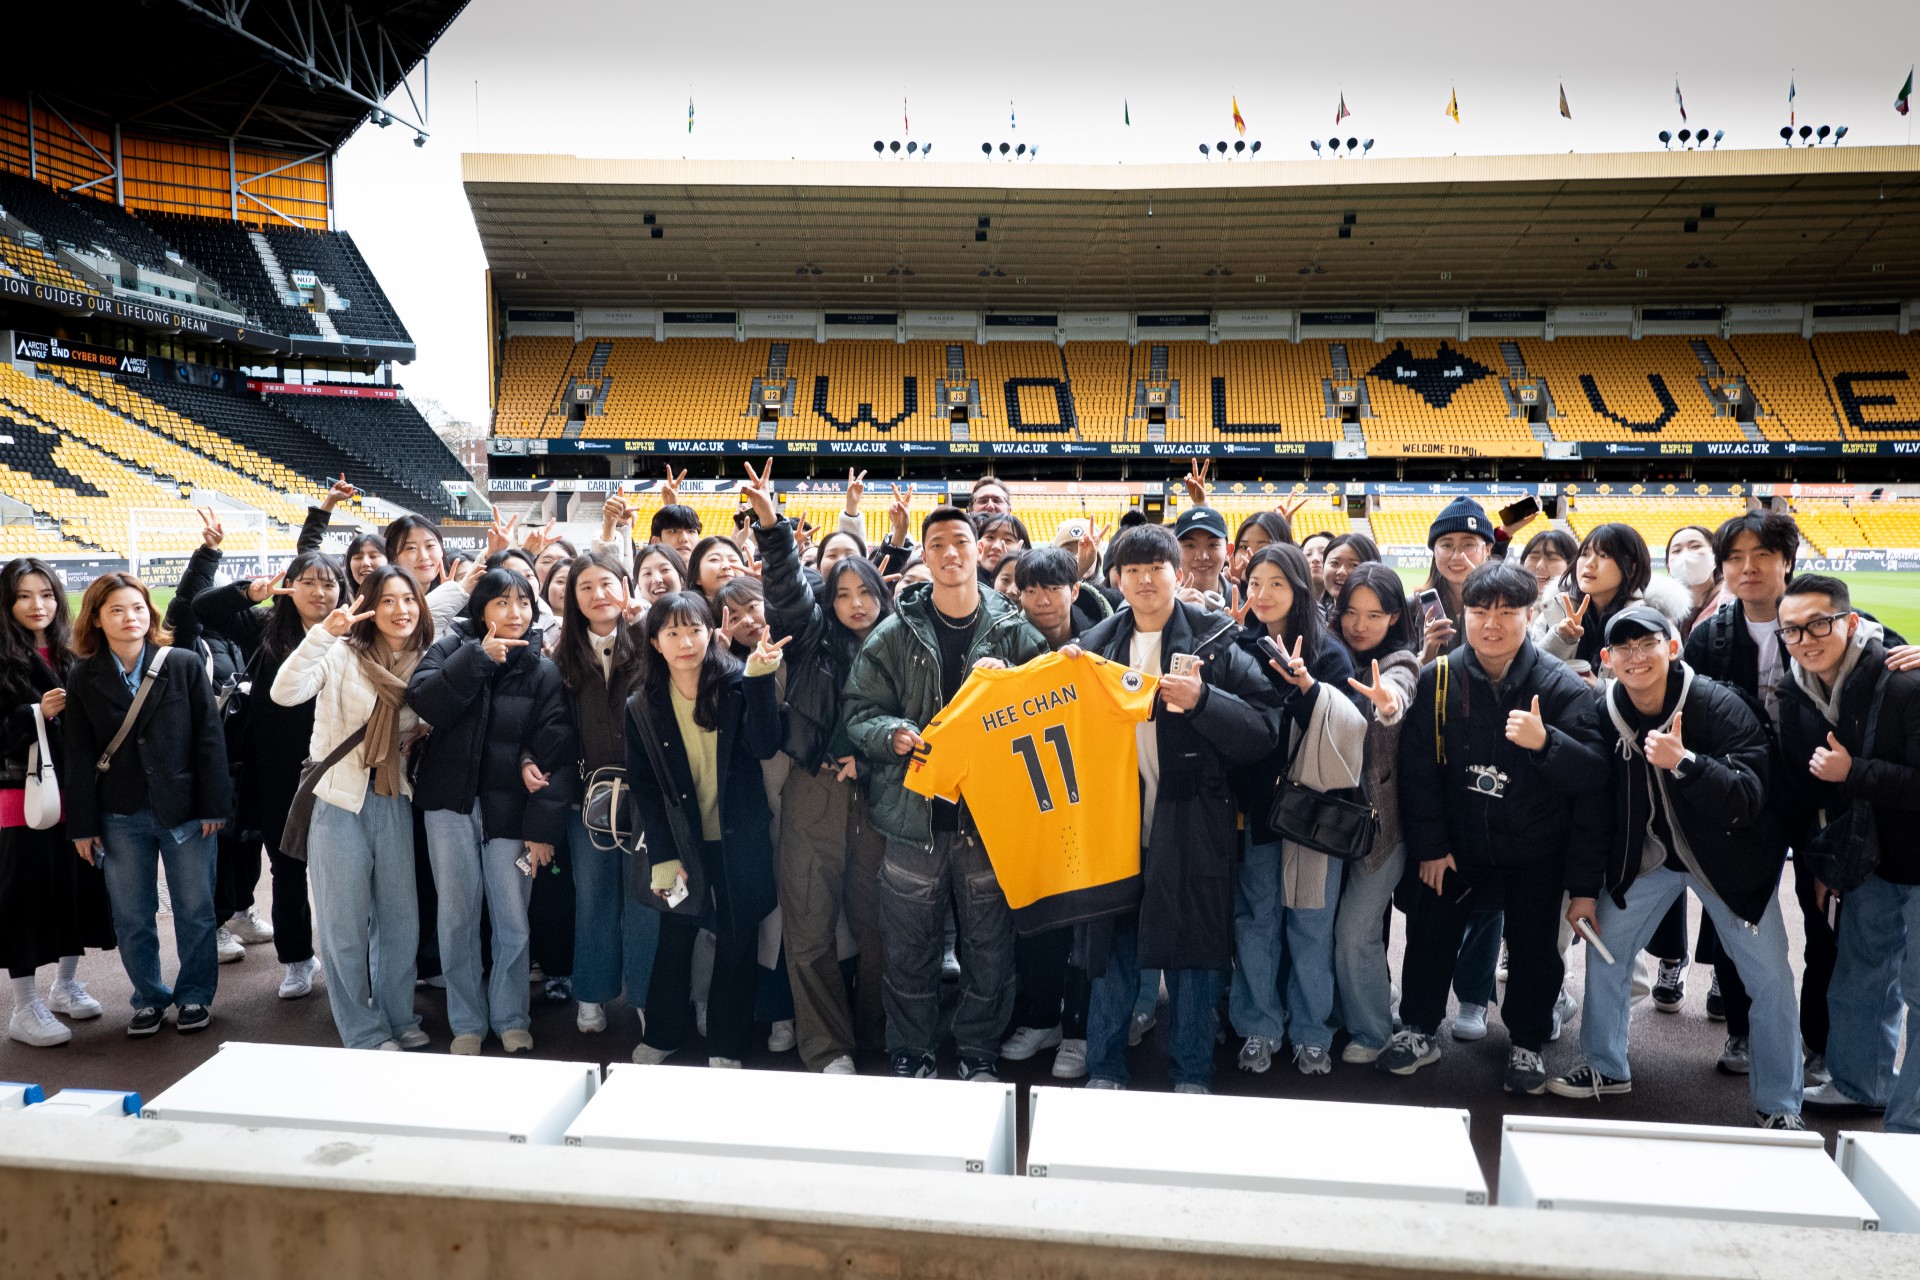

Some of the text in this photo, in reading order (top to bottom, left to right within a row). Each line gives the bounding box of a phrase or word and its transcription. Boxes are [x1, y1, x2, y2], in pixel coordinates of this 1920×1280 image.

[35, 286, 82, 306] GUIDES
[88, 297, 112, 313] OUR
[117, 303, 169, 325] LIFELONG
[174, 315, 208, 332] DREAM
[28, 341, 48, 351] ARCTIC
[31, 350, 47, 358] WOLF
[52, 347, 117, 366] END CYBER RISK
[130, 358, 147, 367] ARCTIC
[132, 365, 146, 374] WOLF
[580, 389, 590, 398] J1
[768, 391, 777, 400] J2
[954, 392, 963, 401] J3
[1152, 393, 1162, 402] J4
[1342, 392, 1352, 400] J5
[1523, 391, 1534, 399] J6
[668, 442, 724, 451] WLV.AC.UK
[830, 443, 887, 452] WLV.AC.UK
[992, 444, 1048, 453] WLV.AC.UK
[1154, 445, 1210, 454] WLV.AC.UK
[1403, 443, 1445, 454] WELCOME
[1448, 444, 1459, 455] TO
[1708, 444, 1769, 453] WLV.AC.UK
[492, 480, 528, 490] CARLING
[679, 481, 704, 490] RLING
[1804, 486, 1855, 495] Trade Natio
[1468, 517, 1477, 529] C
[326, 532, 352, 544] ARCTIC
[442, 537, 475, 548] ETWORKS
[1847, 550, 1885, 560] AstroPay
[1796, 560, 1856, 571] .AC.UK
[140, 567, 150, 575] BE
[152, 567, 170, 575] WHO
[141, 575, 165, 584] WANT
[982, 684, 1078, 732] HEE CHAN
[1012, 723, 1080, 814] 11
